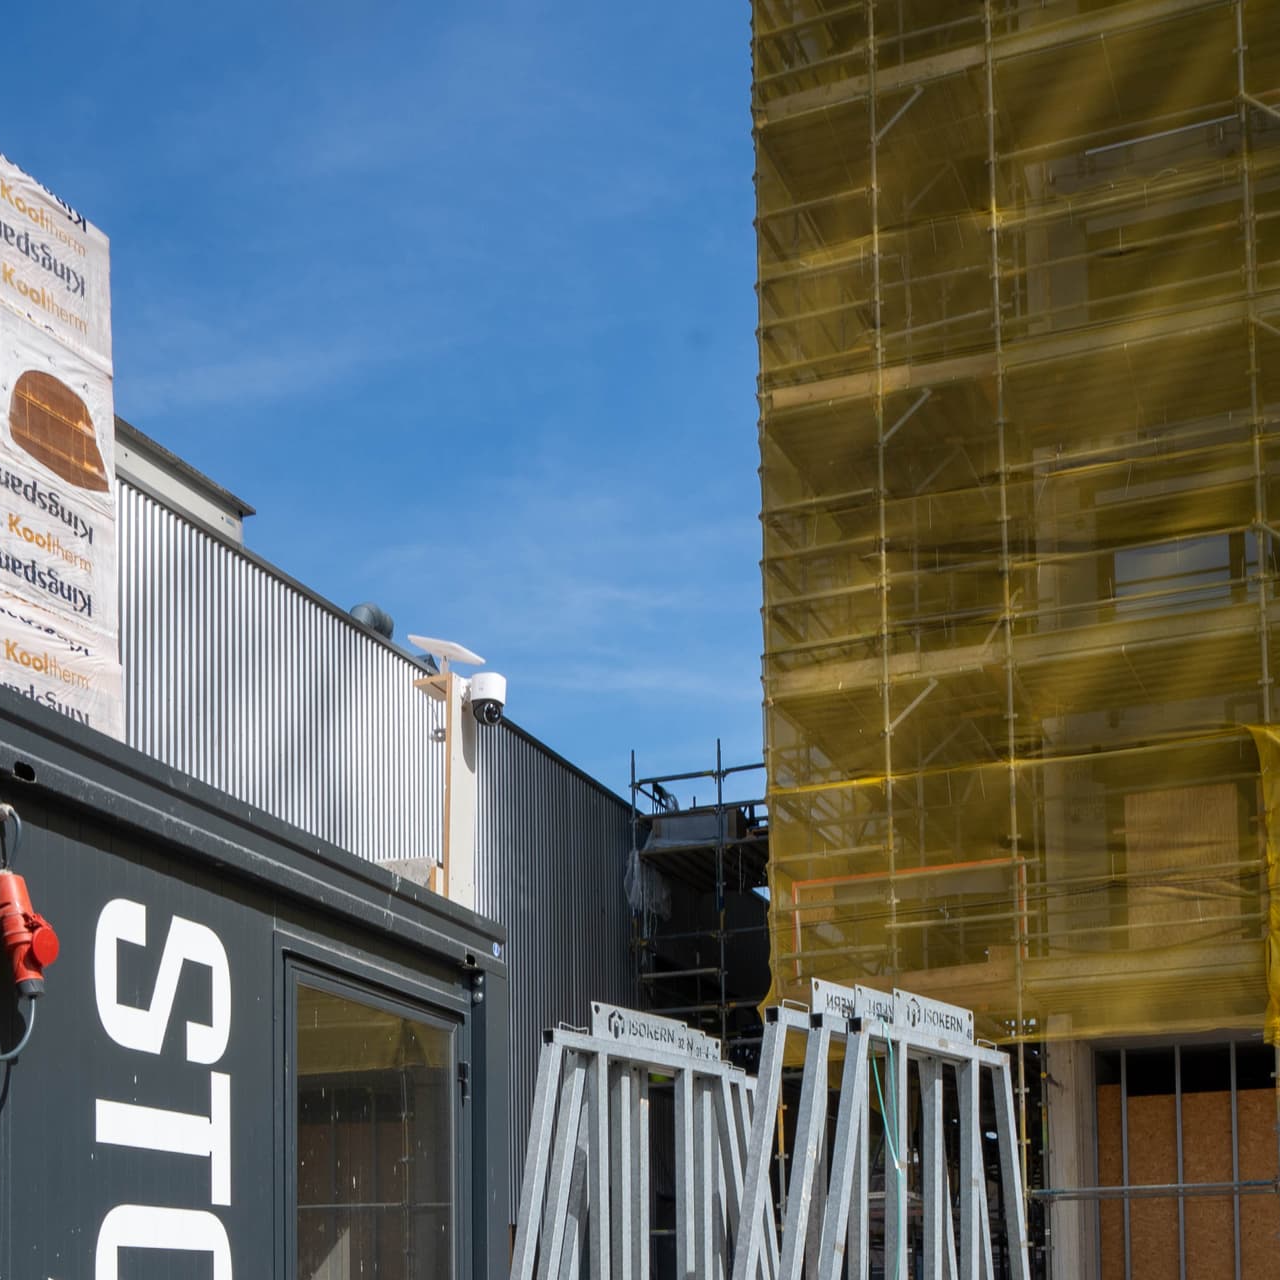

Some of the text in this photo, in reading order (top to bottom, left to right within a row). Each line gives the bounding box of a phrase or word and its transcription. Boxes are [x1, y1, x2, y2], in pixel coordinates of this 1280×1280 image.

[0, 178, 87, 257] Kooltherm
[0, 260, 88, 336] Kooltherm
[7, 511, 93, 573] Kooltherm
[3, 638, 90, 690] Kooltherm
[628, 1018, 675, 1044] ISOKERN
[923, 1007, 963, 1033] ISOKERN
